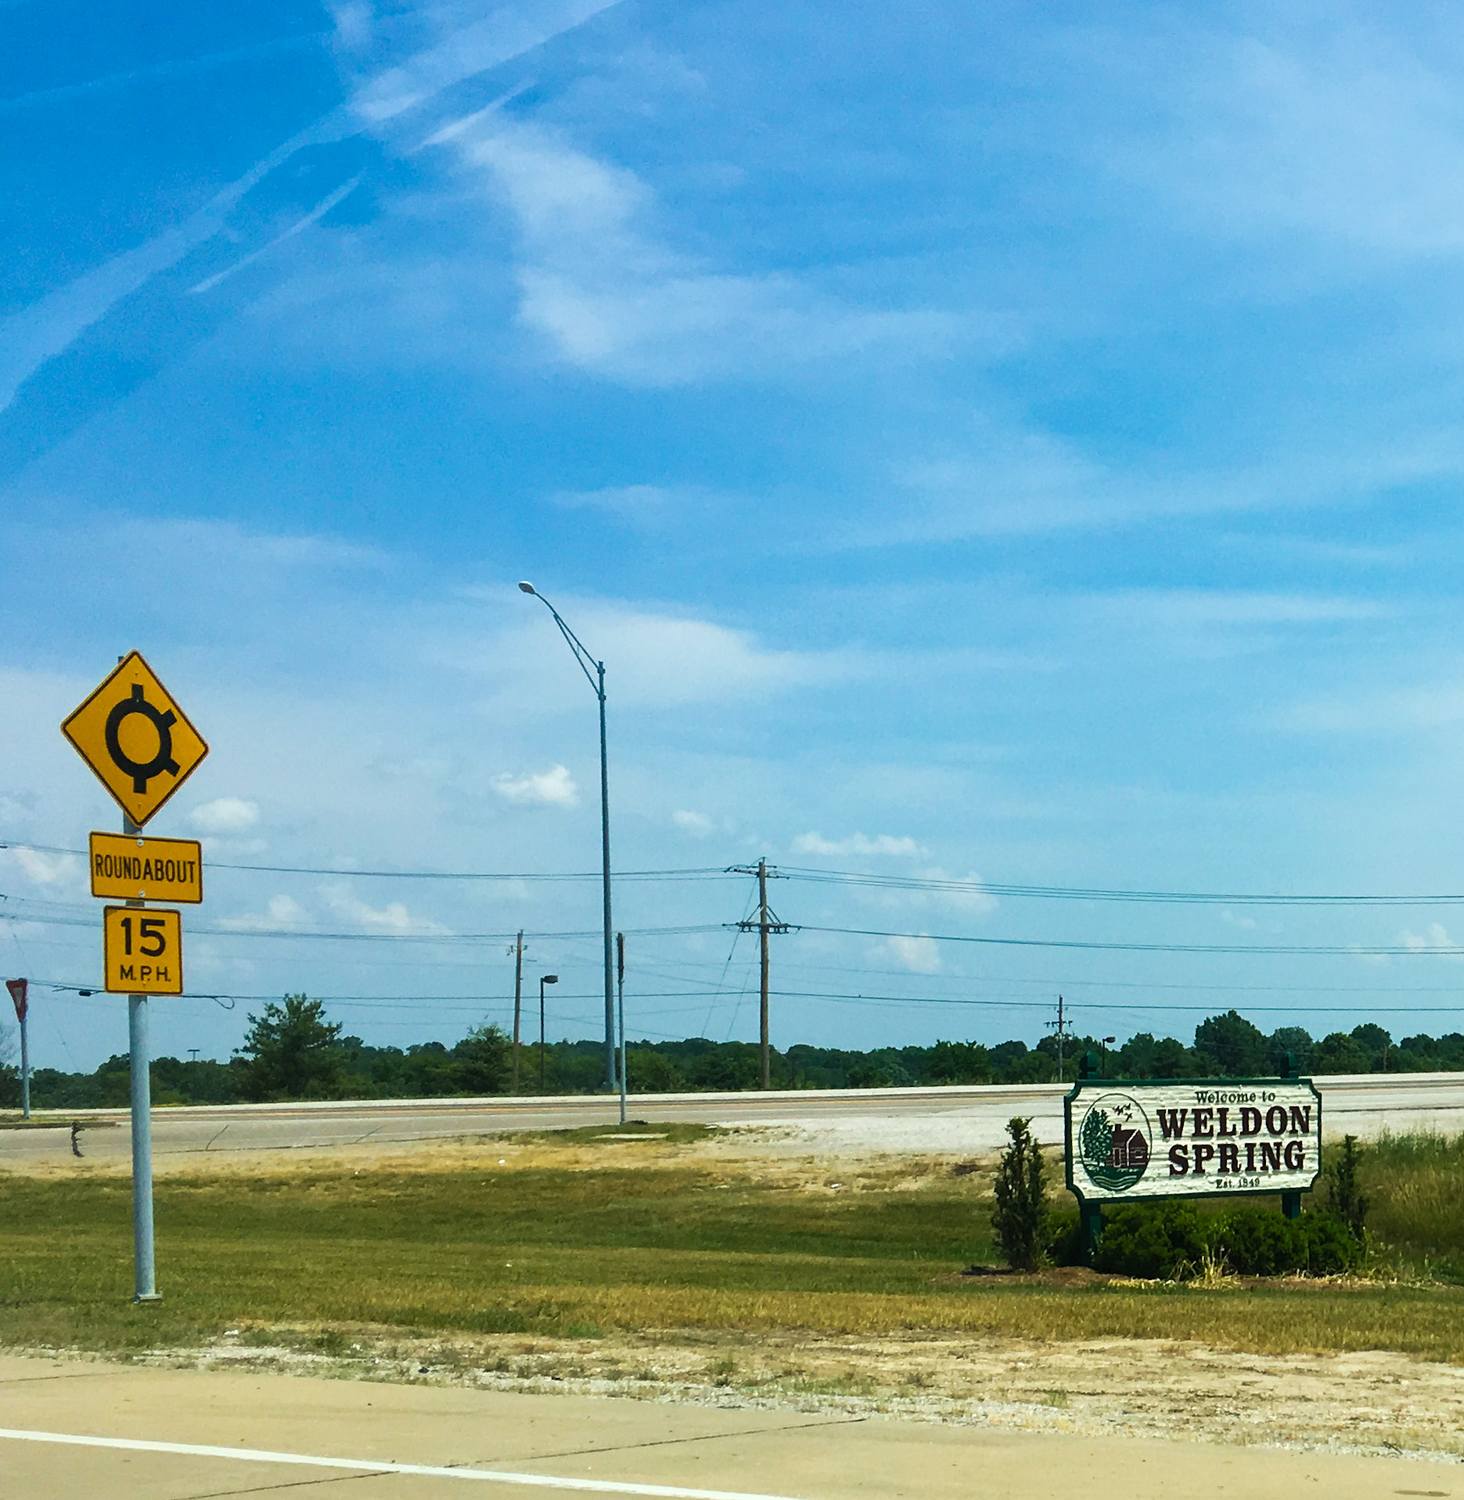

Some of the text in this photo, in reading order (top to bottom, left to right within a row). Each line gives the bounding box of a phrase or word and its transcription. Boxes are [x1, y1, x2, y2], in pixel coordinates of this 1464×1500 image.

[94, 853, 197, 884] ROUNDABOUT
[120, 917, 166, 957] 15
[119, 963, 172, 982] M.P.H.
[1194, 1090, 1276, 1104] Welcome to
[1156, 1104, 1312, 1138] WELDON
[1168, 1140, 1306, 1176] SPRING
[1215, 1177, 1260, 1189] Est. 1849
